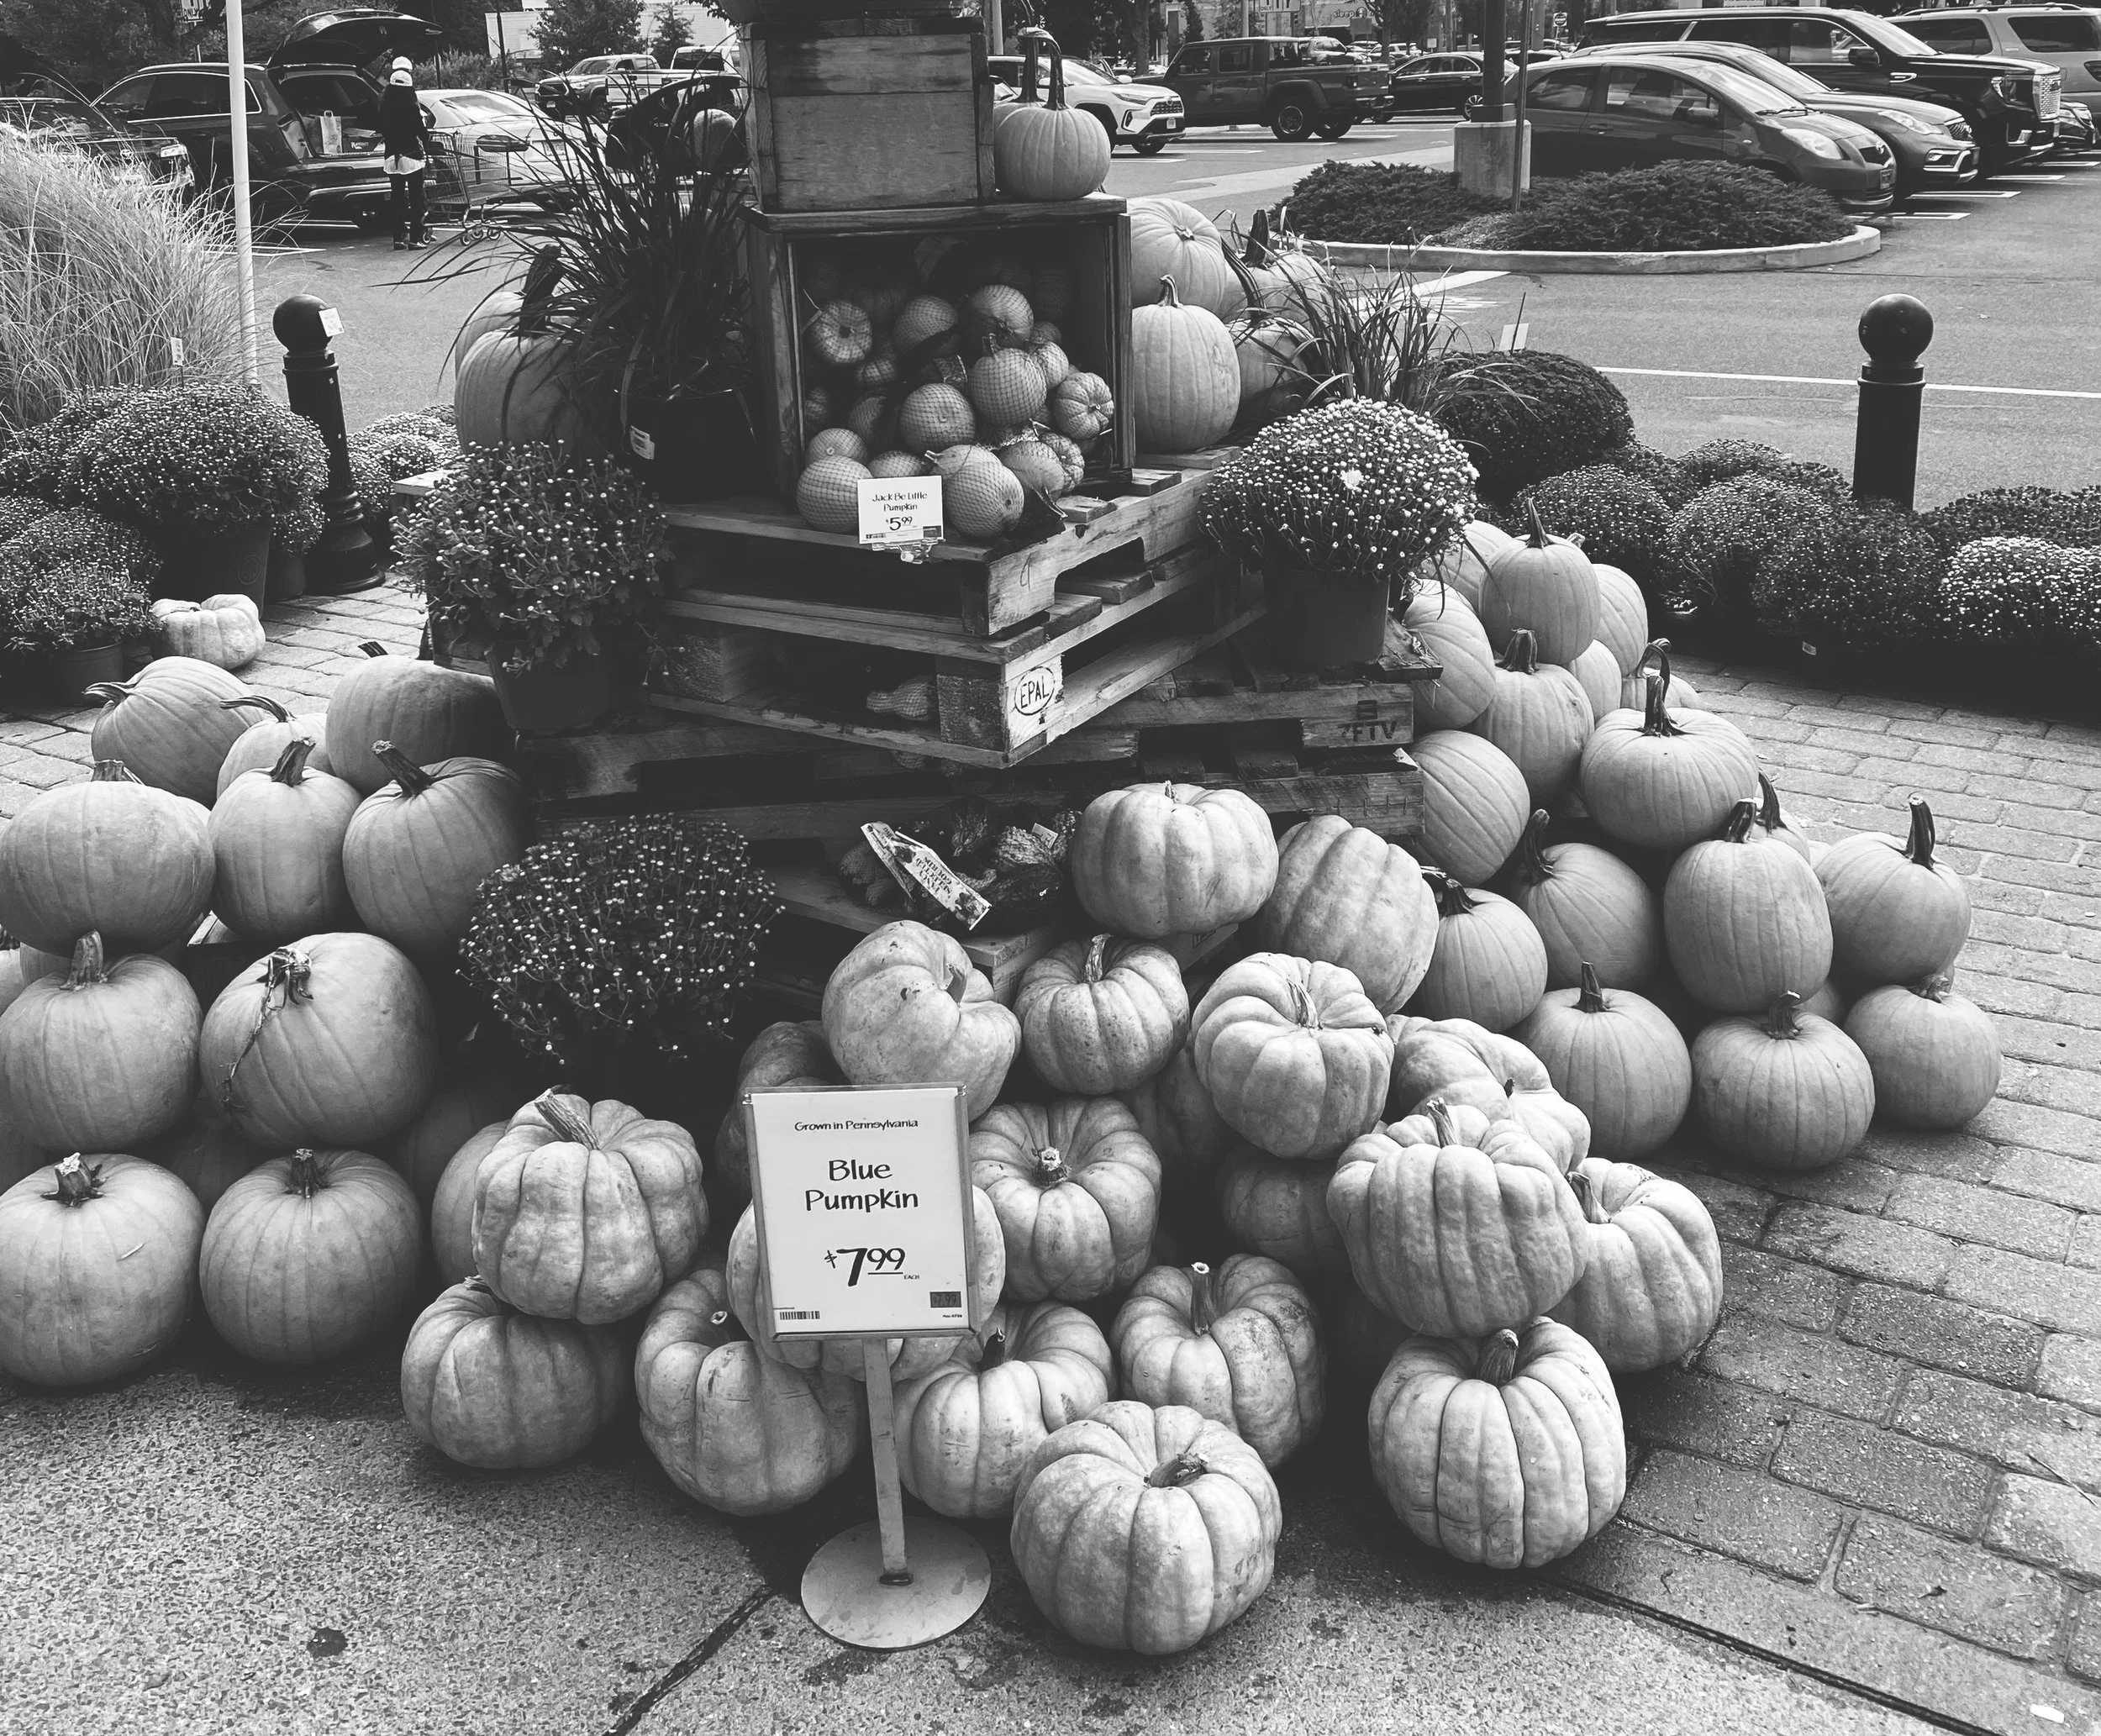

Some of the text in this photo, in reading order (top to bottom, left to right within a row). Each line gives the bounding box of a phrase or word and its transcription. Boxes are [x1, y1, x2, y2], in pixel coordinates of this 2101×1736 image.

[1333, 8, 1355, 18] sleep
[872, 492, 928, 502] Jack Be Little
[883, 503, 918, 512] Pumpkin
[1020, 675, 1049, 708] EPAL
[916, 858, 951, 894] SELECTED
[919, 870, 940, 893] FANCY
[924, 856, 952, 885] GOURDS
[794, 1119, 919, 1132] Grown in Pennsylvania
[829, 1159, 893, 1181] Blue
[805, 1188, 919, 1213] Pumpkin
